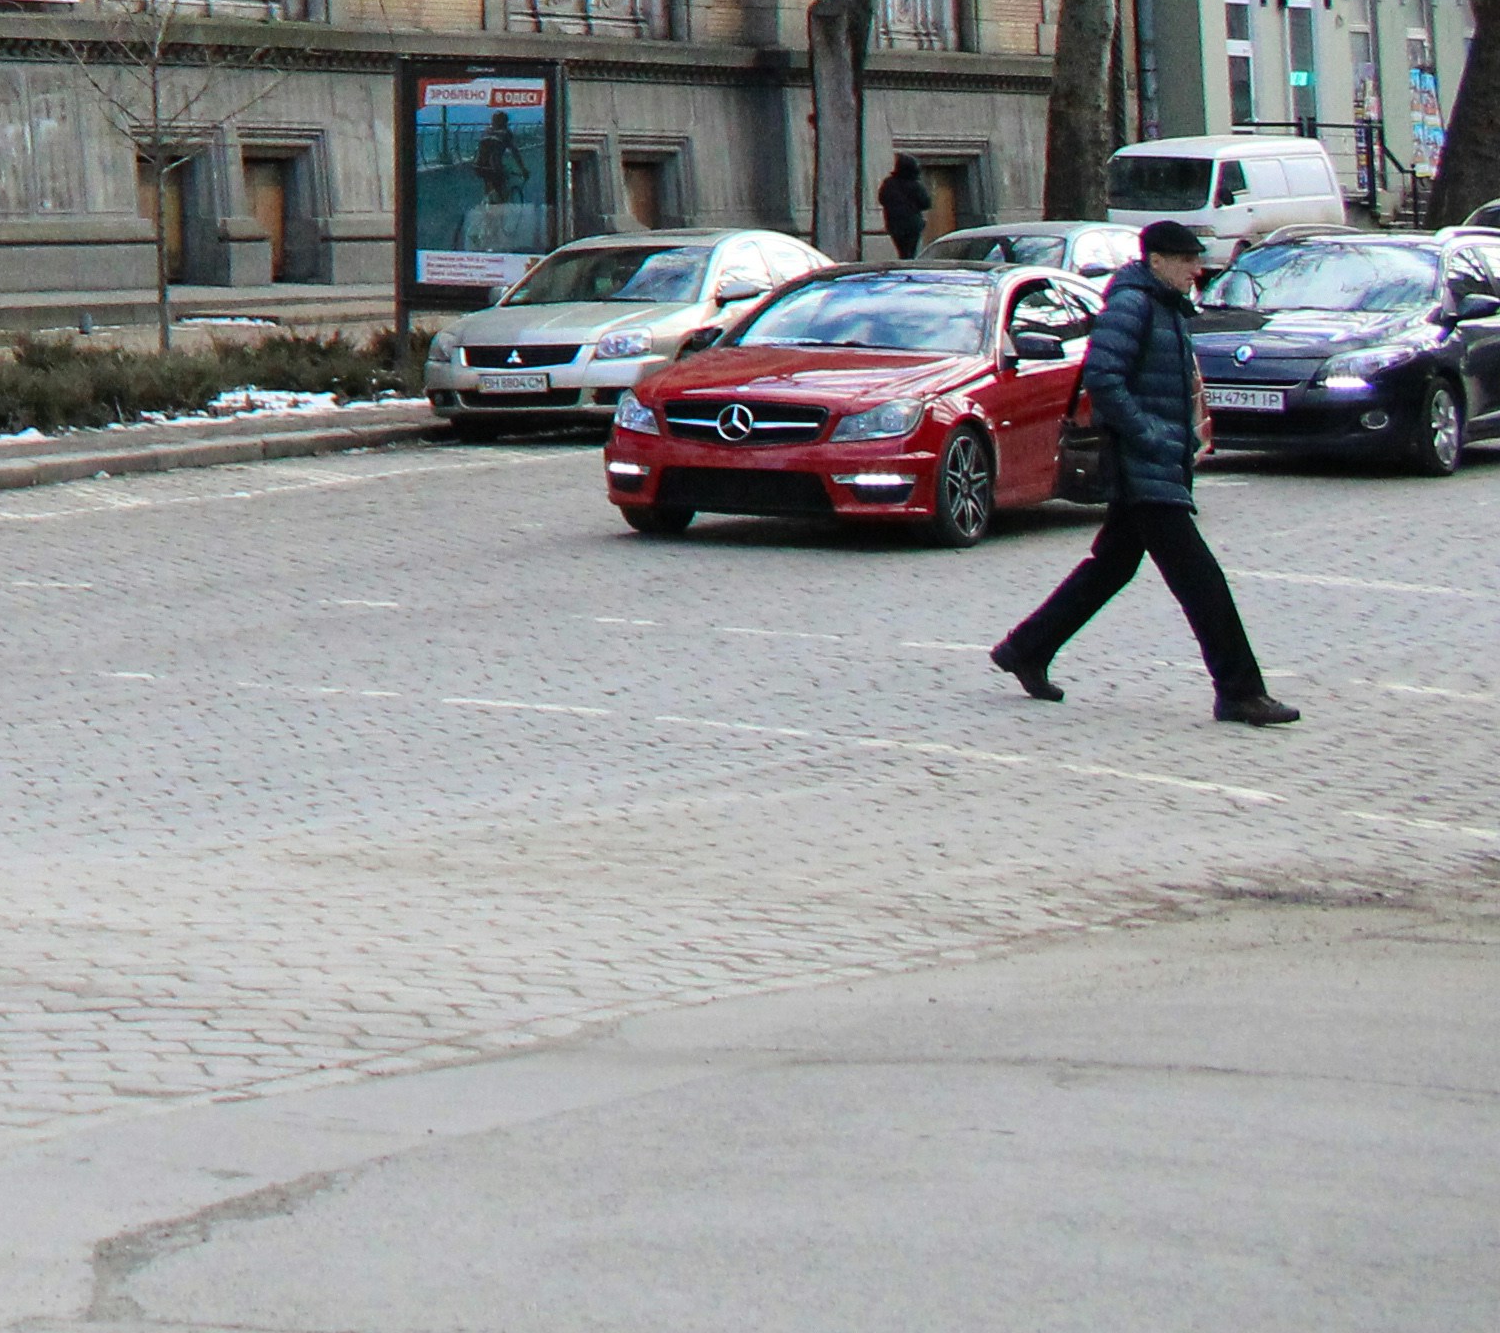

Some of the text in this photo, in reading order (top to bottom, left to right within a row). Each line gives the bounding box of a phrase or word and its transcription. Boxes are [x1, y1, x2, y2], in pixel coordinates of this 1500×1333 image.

[430, 89, 486, 100] ЗРОБЛЕНО
[504, 92, 537, 104] ОДЕСІ
[1225, 391, 1256, 406] 4791
